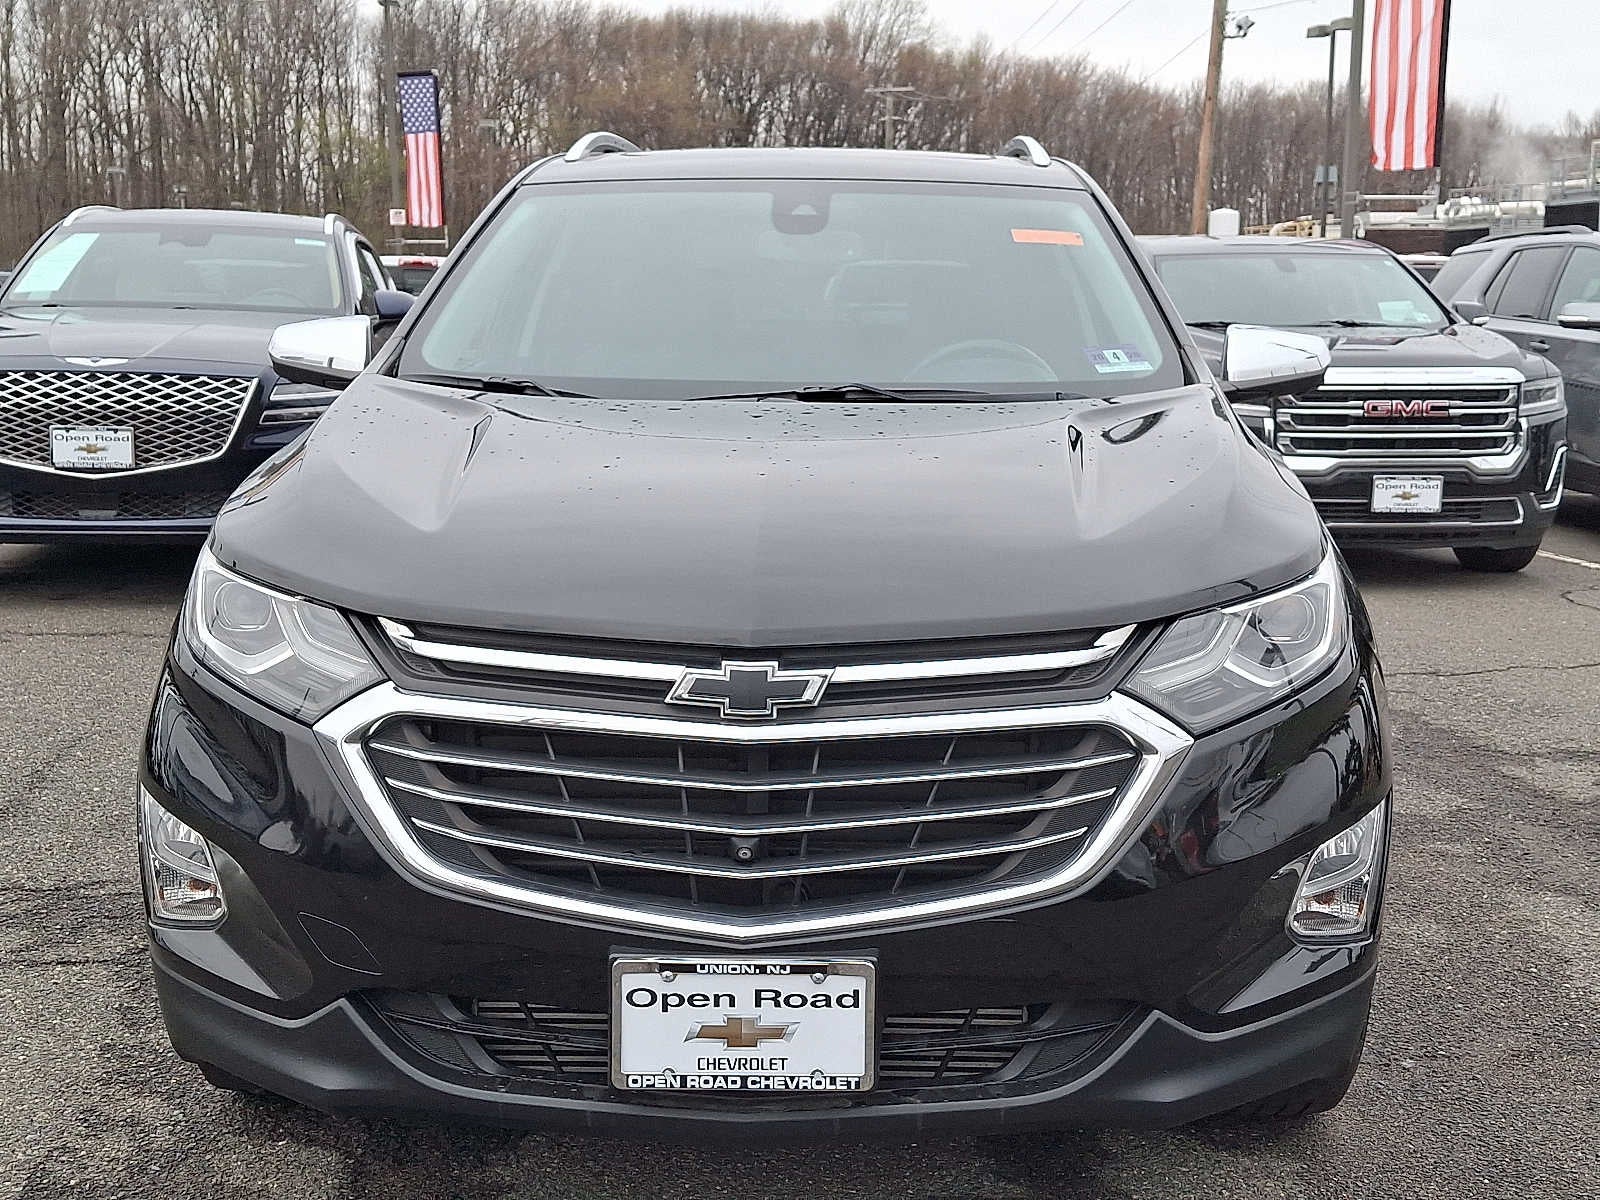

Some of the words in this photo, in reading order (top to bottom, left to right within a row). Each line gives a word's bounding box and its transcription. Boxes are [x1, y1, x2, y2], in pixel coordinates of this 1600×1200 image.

[1112, 351, 1120, 361] 4
[1363, 400, 1449, 417] GMC
[54, 433, 89, 442] Open
[95, 434, 129, 442] Road
[696, 964, 760, 974] UNION,
[766, 965, 791, 974] NJ
[625, 988, 736, 1013] Open
[754, 989, 860, 1009] Road
[697, 1057, 788, 1071] CHEVROLET
[627, 1075, 681, 1089] OPEN
[686, 1075, 741, 1089] ROAD
[747, 1076, 860, 1089] CHEVROLET
